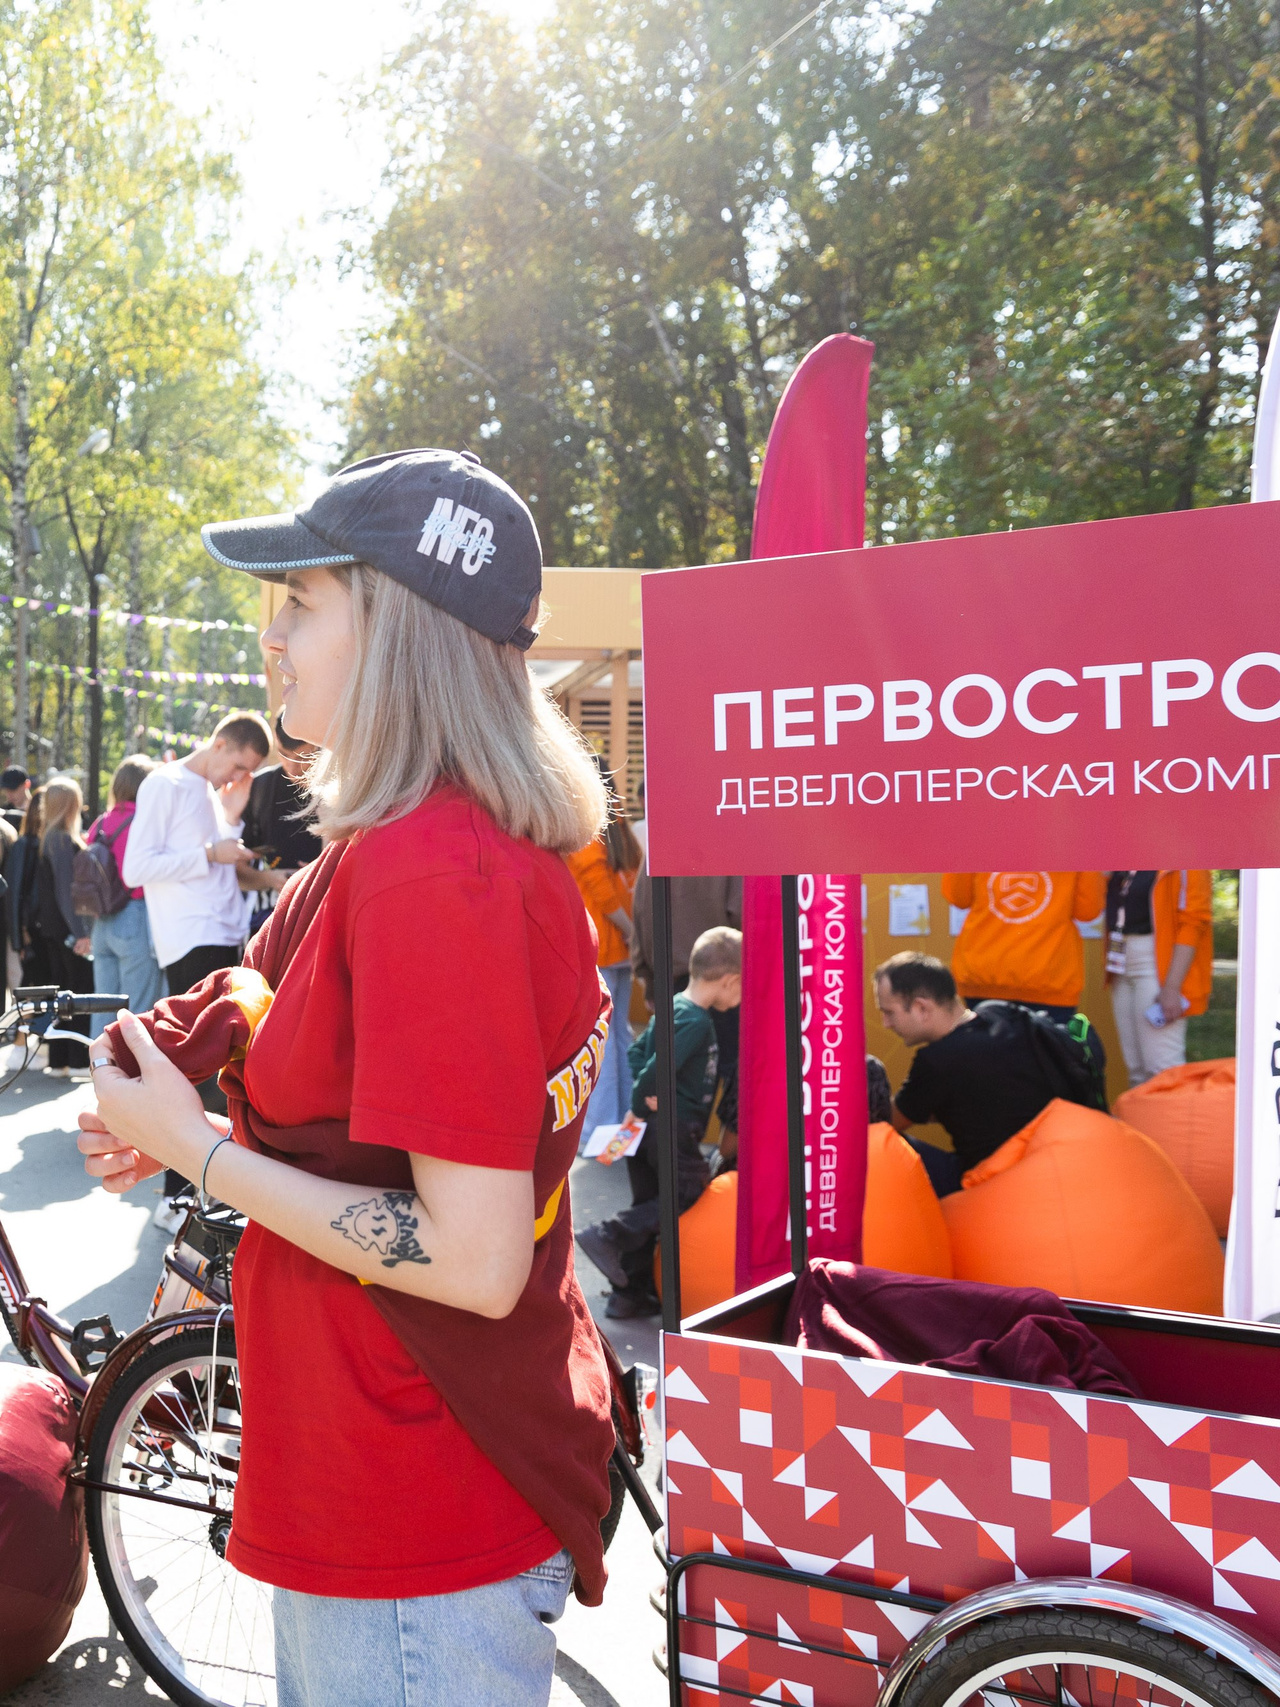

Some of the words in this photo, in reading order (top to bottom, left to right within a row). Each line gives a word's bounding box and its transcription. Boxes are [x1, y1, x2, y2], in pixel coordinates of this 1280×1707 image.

[714, 652, 1280, 752] ПЕРВОСТРО
[716, 762, 1115, 816] ДЕВЕЛОПЕРСКАЯ
[819, 969, 844, 1232] ДЕВЕЛОПЕРСКАЯ
